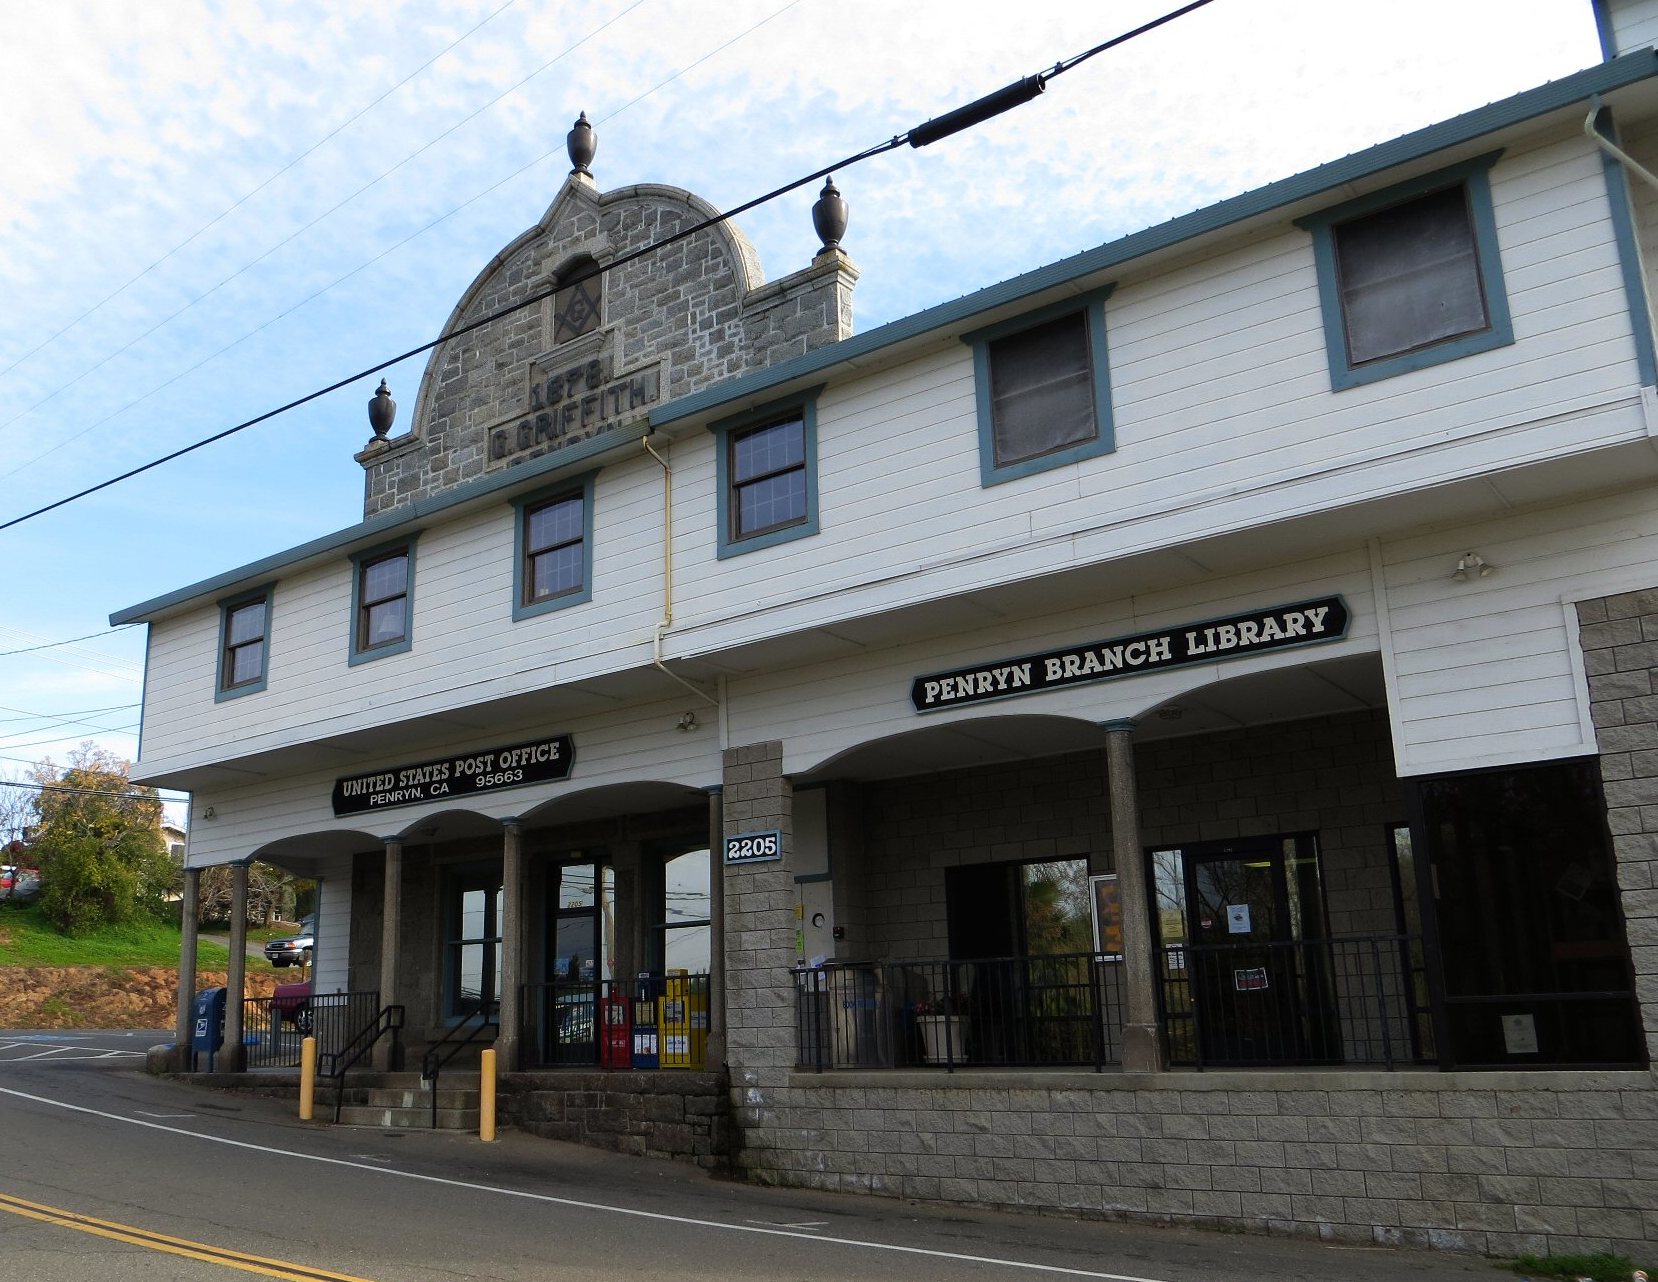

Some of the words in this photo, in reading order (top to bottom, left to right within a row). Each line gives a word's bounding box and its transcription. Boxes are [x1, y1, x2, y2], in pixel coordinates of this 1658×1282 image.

[925, 663, 1031, 703] PENRYN
[1045, 636, 1171, 682] BRANCH
[1186, 606, 1329, 655] LIBRARY
[343, 773, 395, 797] UNITED
[399, 762, 450, 787] STATES
[455, 754, 495, 777] POST
[499, 742, 560, 768] OFFICE
[476, 769, 523, 788] 95663
[370, 786, 424, 806] PENRYN,
[430, 782, 450, 795] CA
[728, 836, 777, 859] 2205
